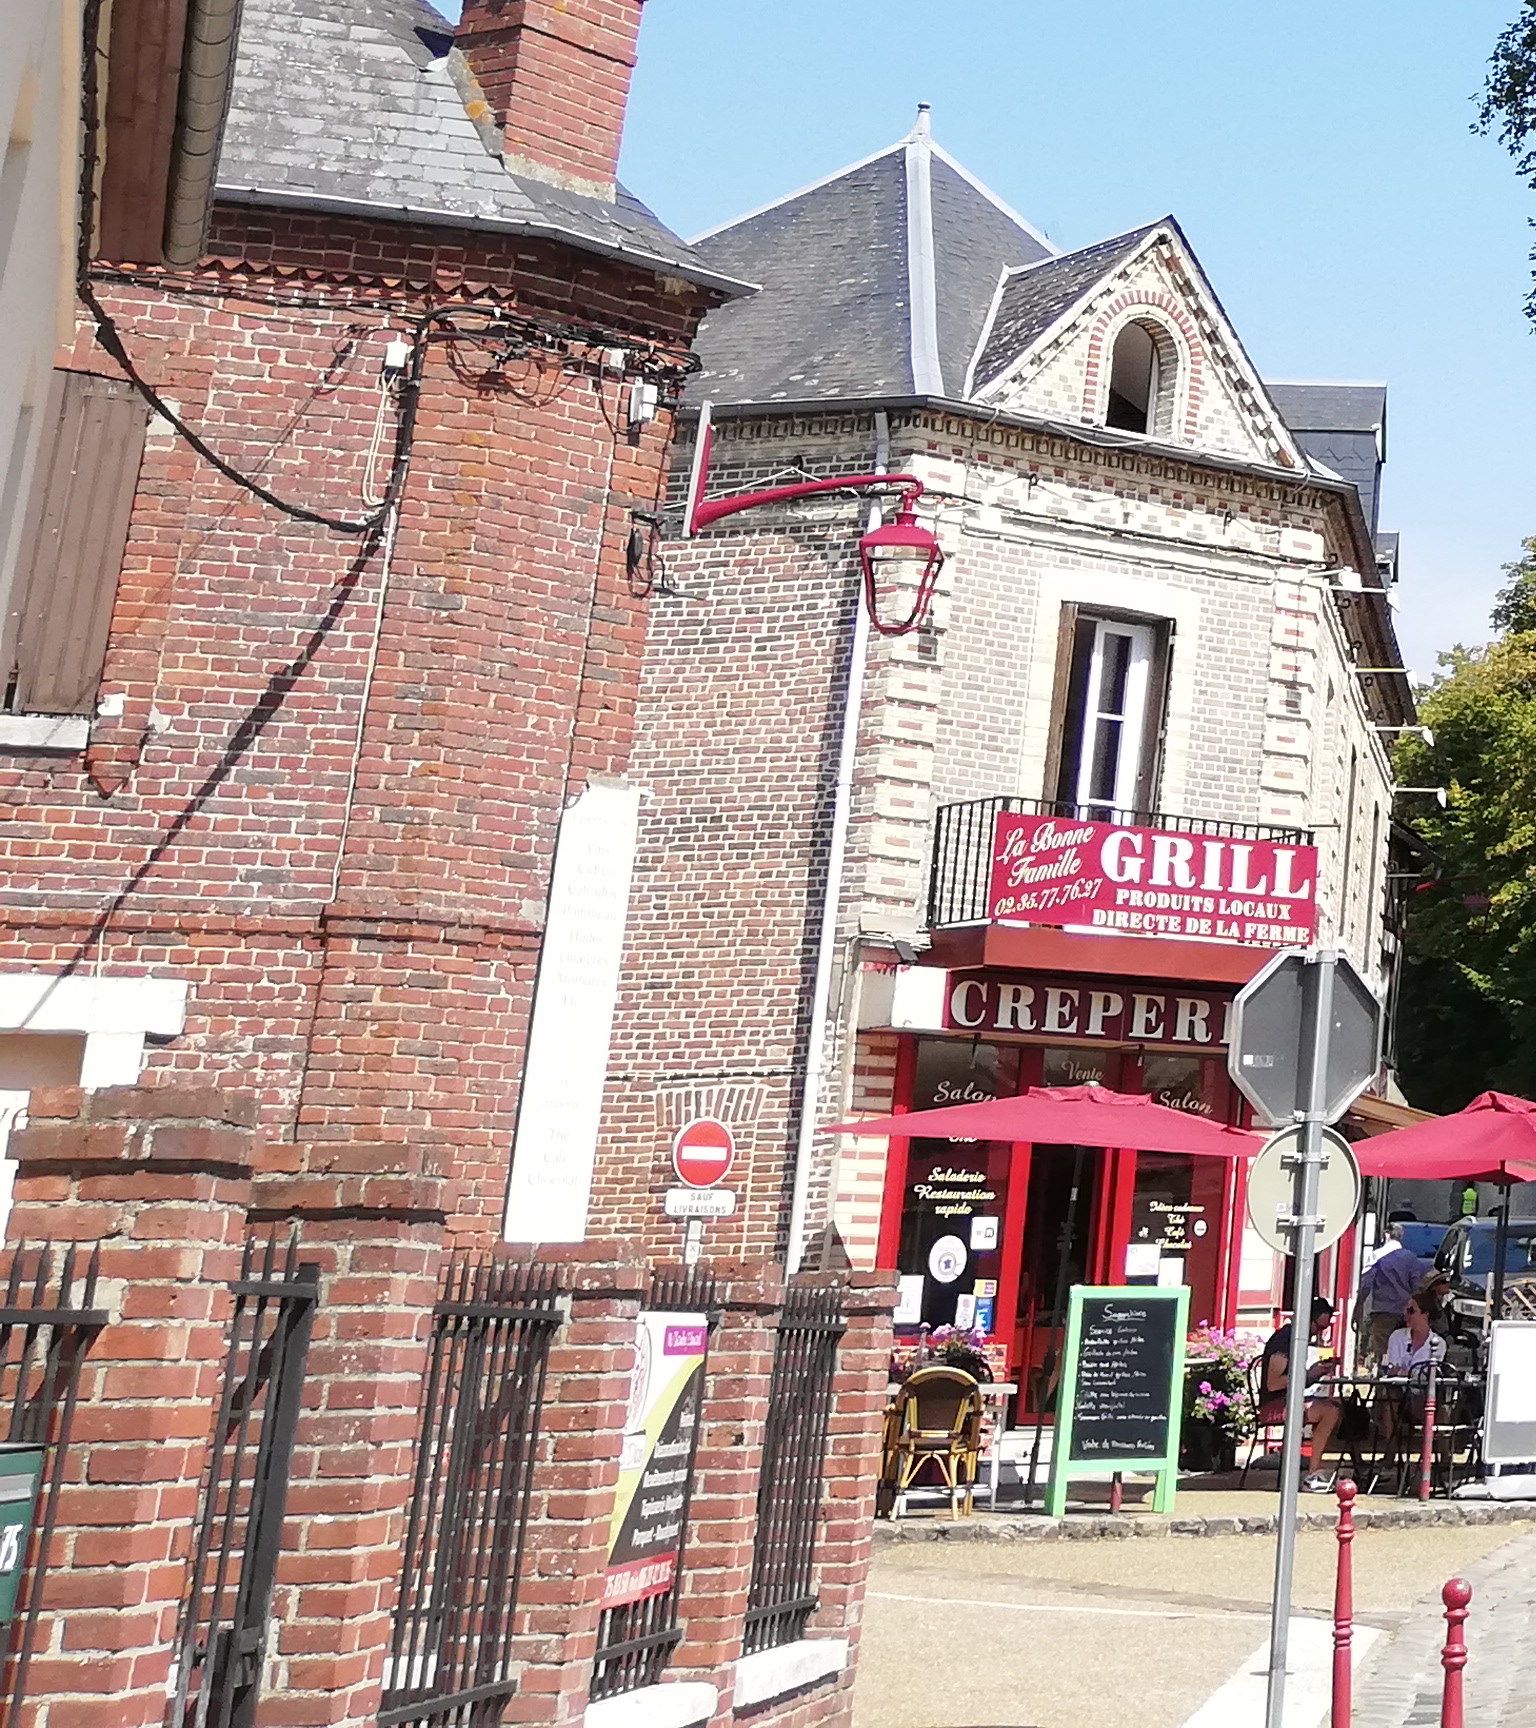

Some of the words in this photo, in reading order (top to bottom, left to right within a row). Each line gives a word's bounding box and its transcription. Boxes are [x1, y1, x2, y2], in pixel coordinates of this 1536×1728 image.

[996, 827, 1028, 865] La
[1030, 820, 1096, 853] Bonne
[1007, 847, 1083, 888] Famille
[1100, 829, 1310, 900] GRILL
[1115, 888, 1215, 914] PRODUITS
[1218, 898, 1292, 921] LOCAUX
[1092, 909, 1182, 933] DIRECTE
[1185, 916, 1212, 935] DE
[1215, 920, 1241, 938] LA
[1244, 922, 1310, 943] FERME
[1060, 1060, 1105, 1081] Vente
[1159, 1090, 1213, 1114] Salon
[527, 1171, 578, 1186] Chocolat
[927, 1166, 986, 1183] Saladerie
[690, 1192, 714, 1201] SAUF
[913, 1183, 997, 1200] Restauration
[673, 1204, 727, 1215] LIVRAISONS
[934, 1201, 973, 1219] rapide
